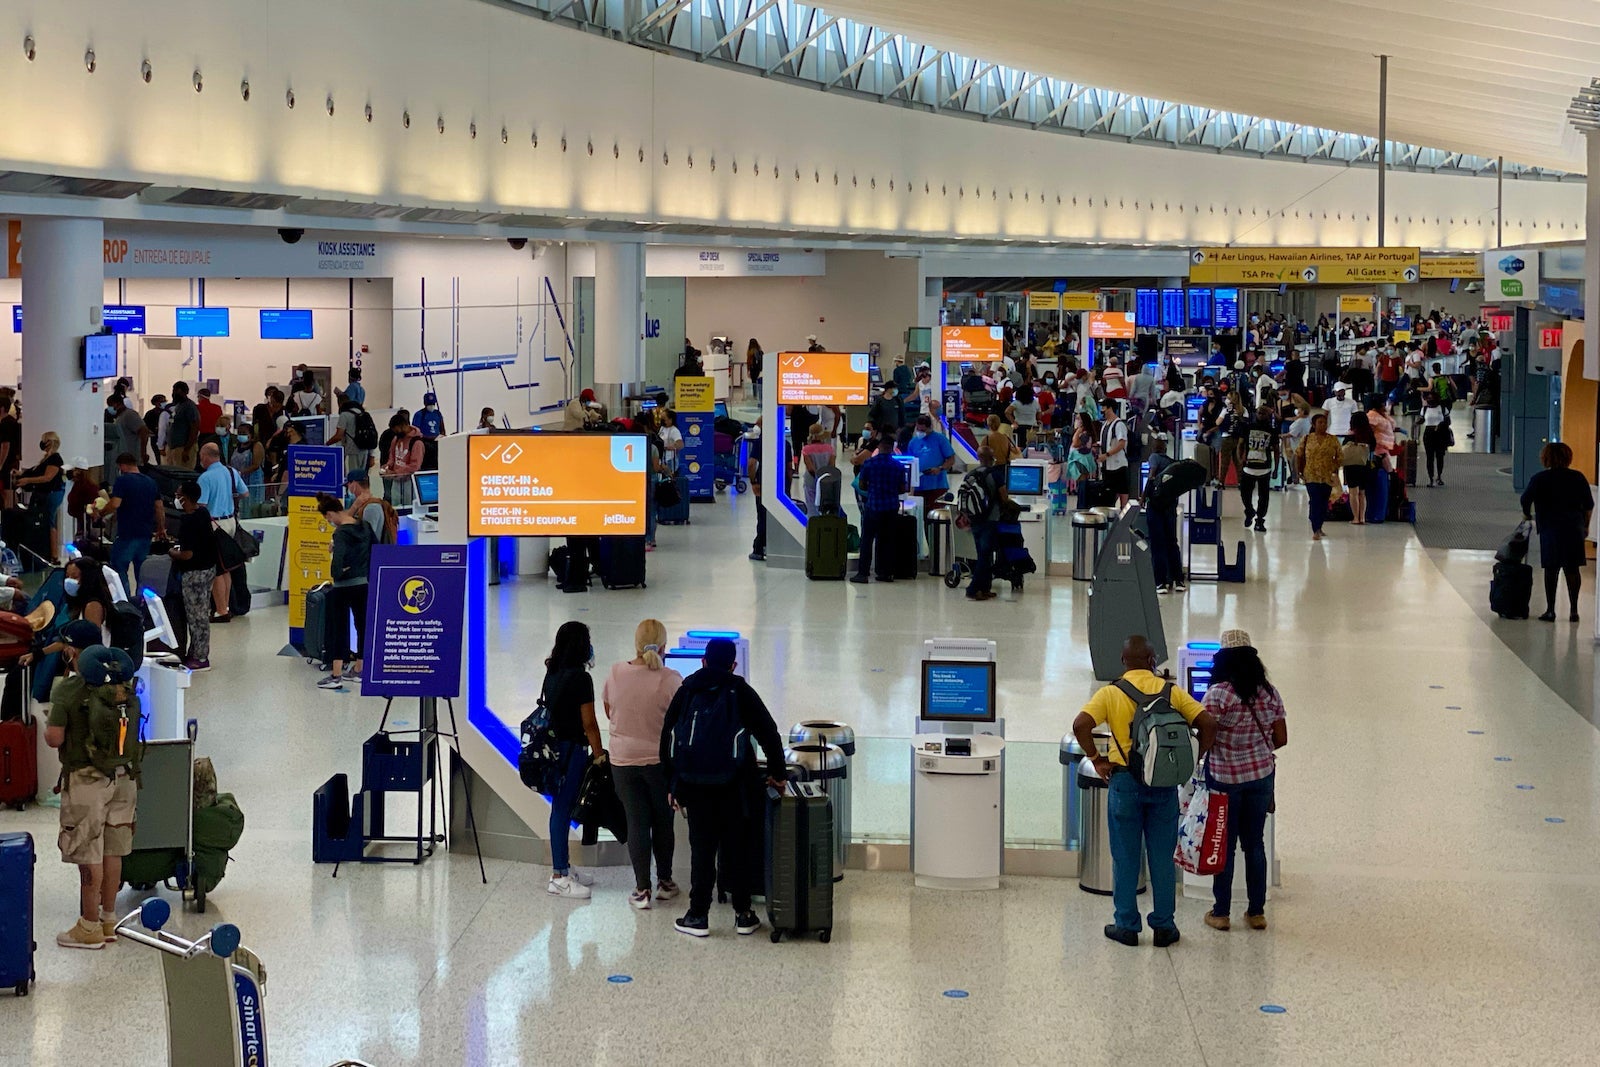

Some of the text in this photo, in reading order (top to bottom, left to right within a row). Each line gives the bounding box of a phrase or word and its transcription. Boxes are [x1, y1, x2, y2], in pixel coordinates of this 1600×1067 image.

[318, 242, 376, 256] KIOSK ASSISTANCE
[134, 249, 168, 264] ENTREGA
[169, 250, 178, 264] DE
[179, 250, 211, 265] EQUIPAJE
[1238, 253, 1266, 263] Lingus,
[1310, 253, 1343, 262] Airlines,
[1378, 253, 1414, 262] Portugal
[1492, 316, 1511, 330] EXIT
[624, 444, 633, 462] 1
[308, 459, 326, 467] safety
[481, 475, 531, 485] CHECK-IN
[481, 487, 553, 496] TAG YOUR BAG
[481, 508, 522, 516] CHECK-IN
[604, 514, 636, 526] jetBlue
[1207, 806, 1224, 865] Burlington
